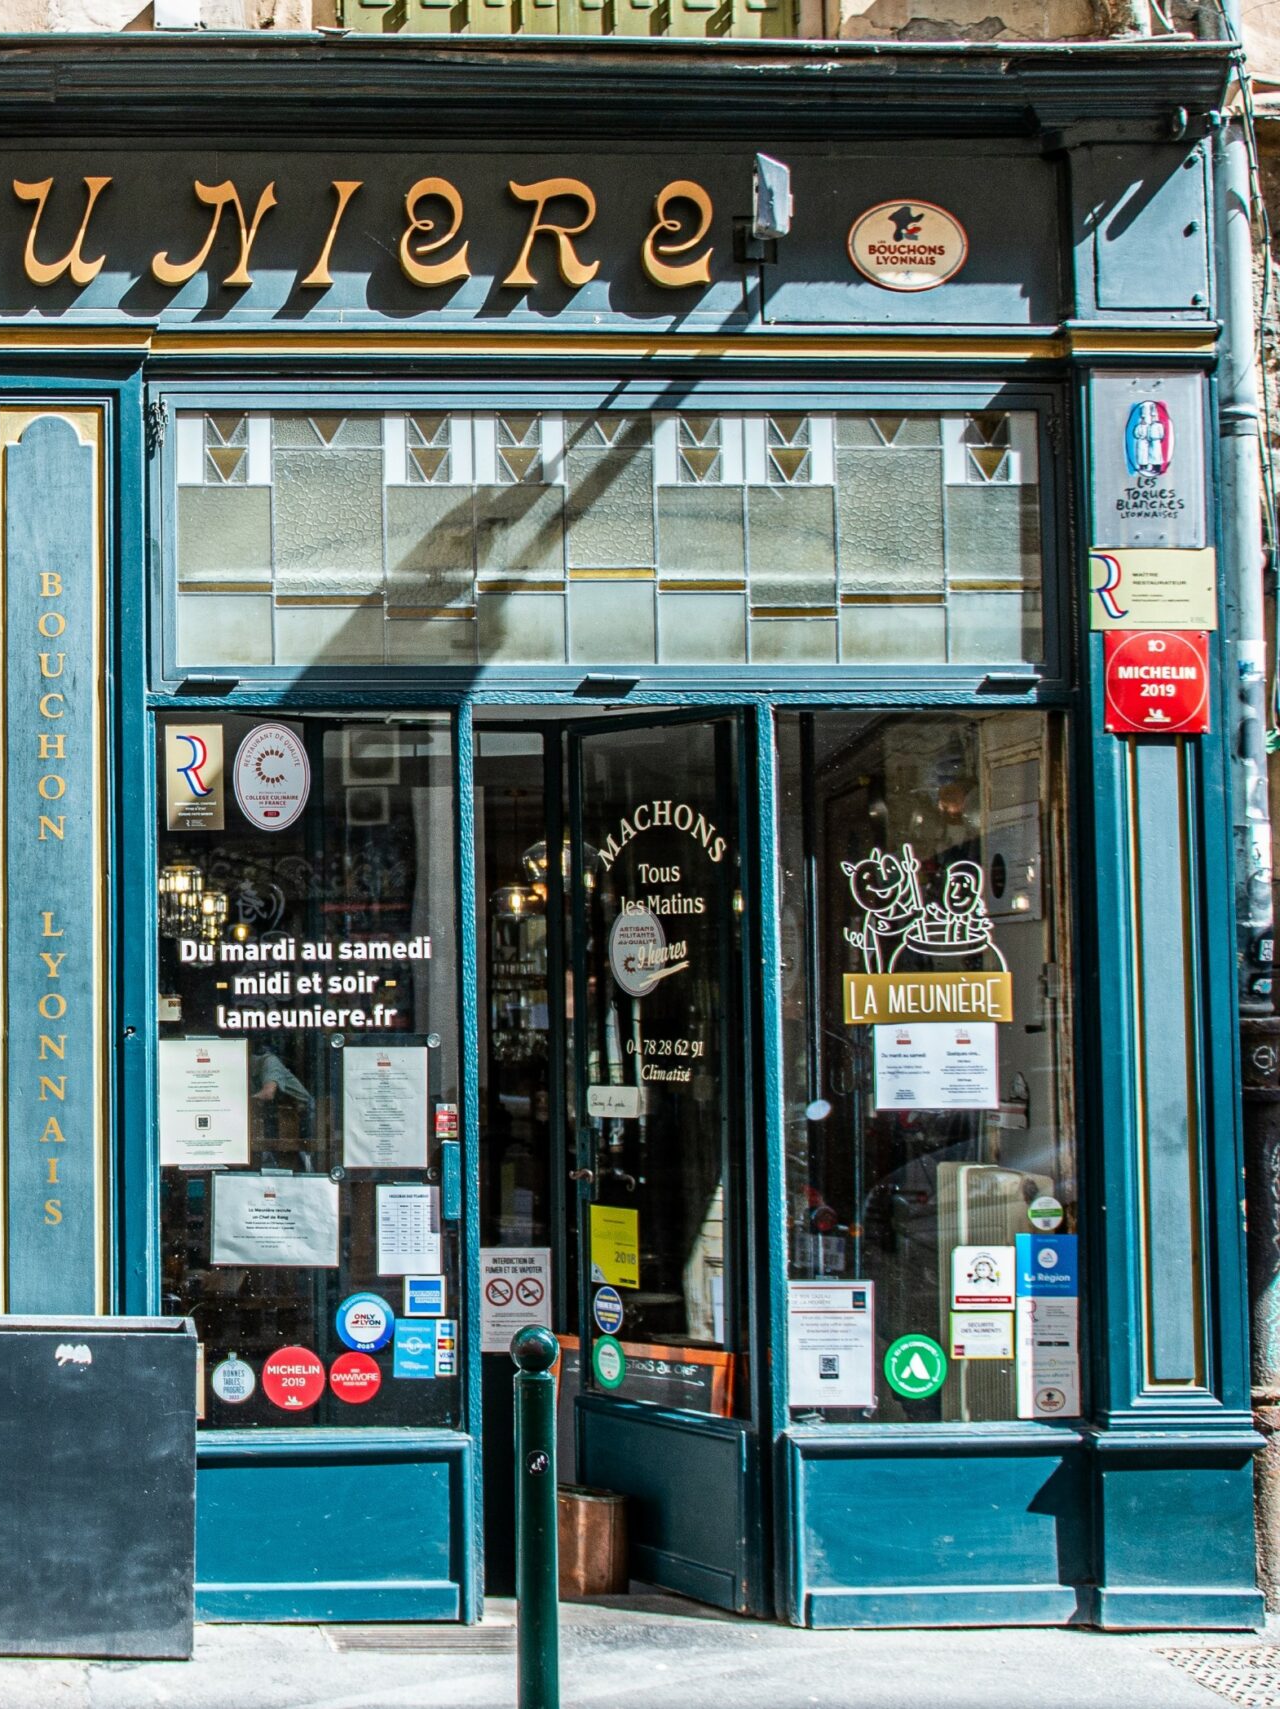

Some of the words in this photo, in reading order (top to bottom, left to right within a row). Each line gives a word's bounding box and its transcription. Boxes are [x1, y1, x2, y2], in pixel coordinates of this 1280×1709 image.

[868, 244, 945, 256] BOUCHONS
[876, 256, 936, 266] LYONNAIS
[1117, 665, 1197, 680] MICHELIN
[1140, 684, 1175, 697] 2019
[37, 571, 67, 840] BOUCHON
[597, 800, 727, 872] MACHONS
[638, 863, 681, 884] Tous
[620, 895, 645, 916] les
[648, 893, 706, 916] Matins
[180, 939, 214, 962] Du
[221, 938, 296, 962] mardi
[300, 943, 333, 960] au
[338, 936, 432, 960] samedi
[646, 939, 687, 965] heures
[233, 971, 290, 995] midi
[296, 972, 323, 994] et
[327, 970, 380, 994] soir
[850, 981, 878, 1019] LA
[888, 976, 1002, 1018] MEUNIÈRE
[216, 1003, 398, 1030] lameuniere.fr
[643, 1040, 657, 1056] 78
[658, 1040, 673, 1056] 28
[674, 1040, 689, 1056] 62
[691, 1040, 704, 1057] 91
[37, 911, 67, 1226] LYONNAIS
[641, 1063, 691, 1082] Climatisé
[485, 1266, 503, 1274] FUMER
[503, 1266, 510, 1274] ET
[511, 1266, 518, 1274] DE
[520, 1266, 543, 1274] VAPOTER
[492, 1257, 527, 1265] INTERDICTION
[528, 1257, 535, 1265] DE
[1037, 1272, 1071, 1283] Région
[267, 1365, 320, 1375] MICHELIN
[331, 1373, 379, 1382] OMNIVORE
[281, 1377, 306, 1387] 2019
